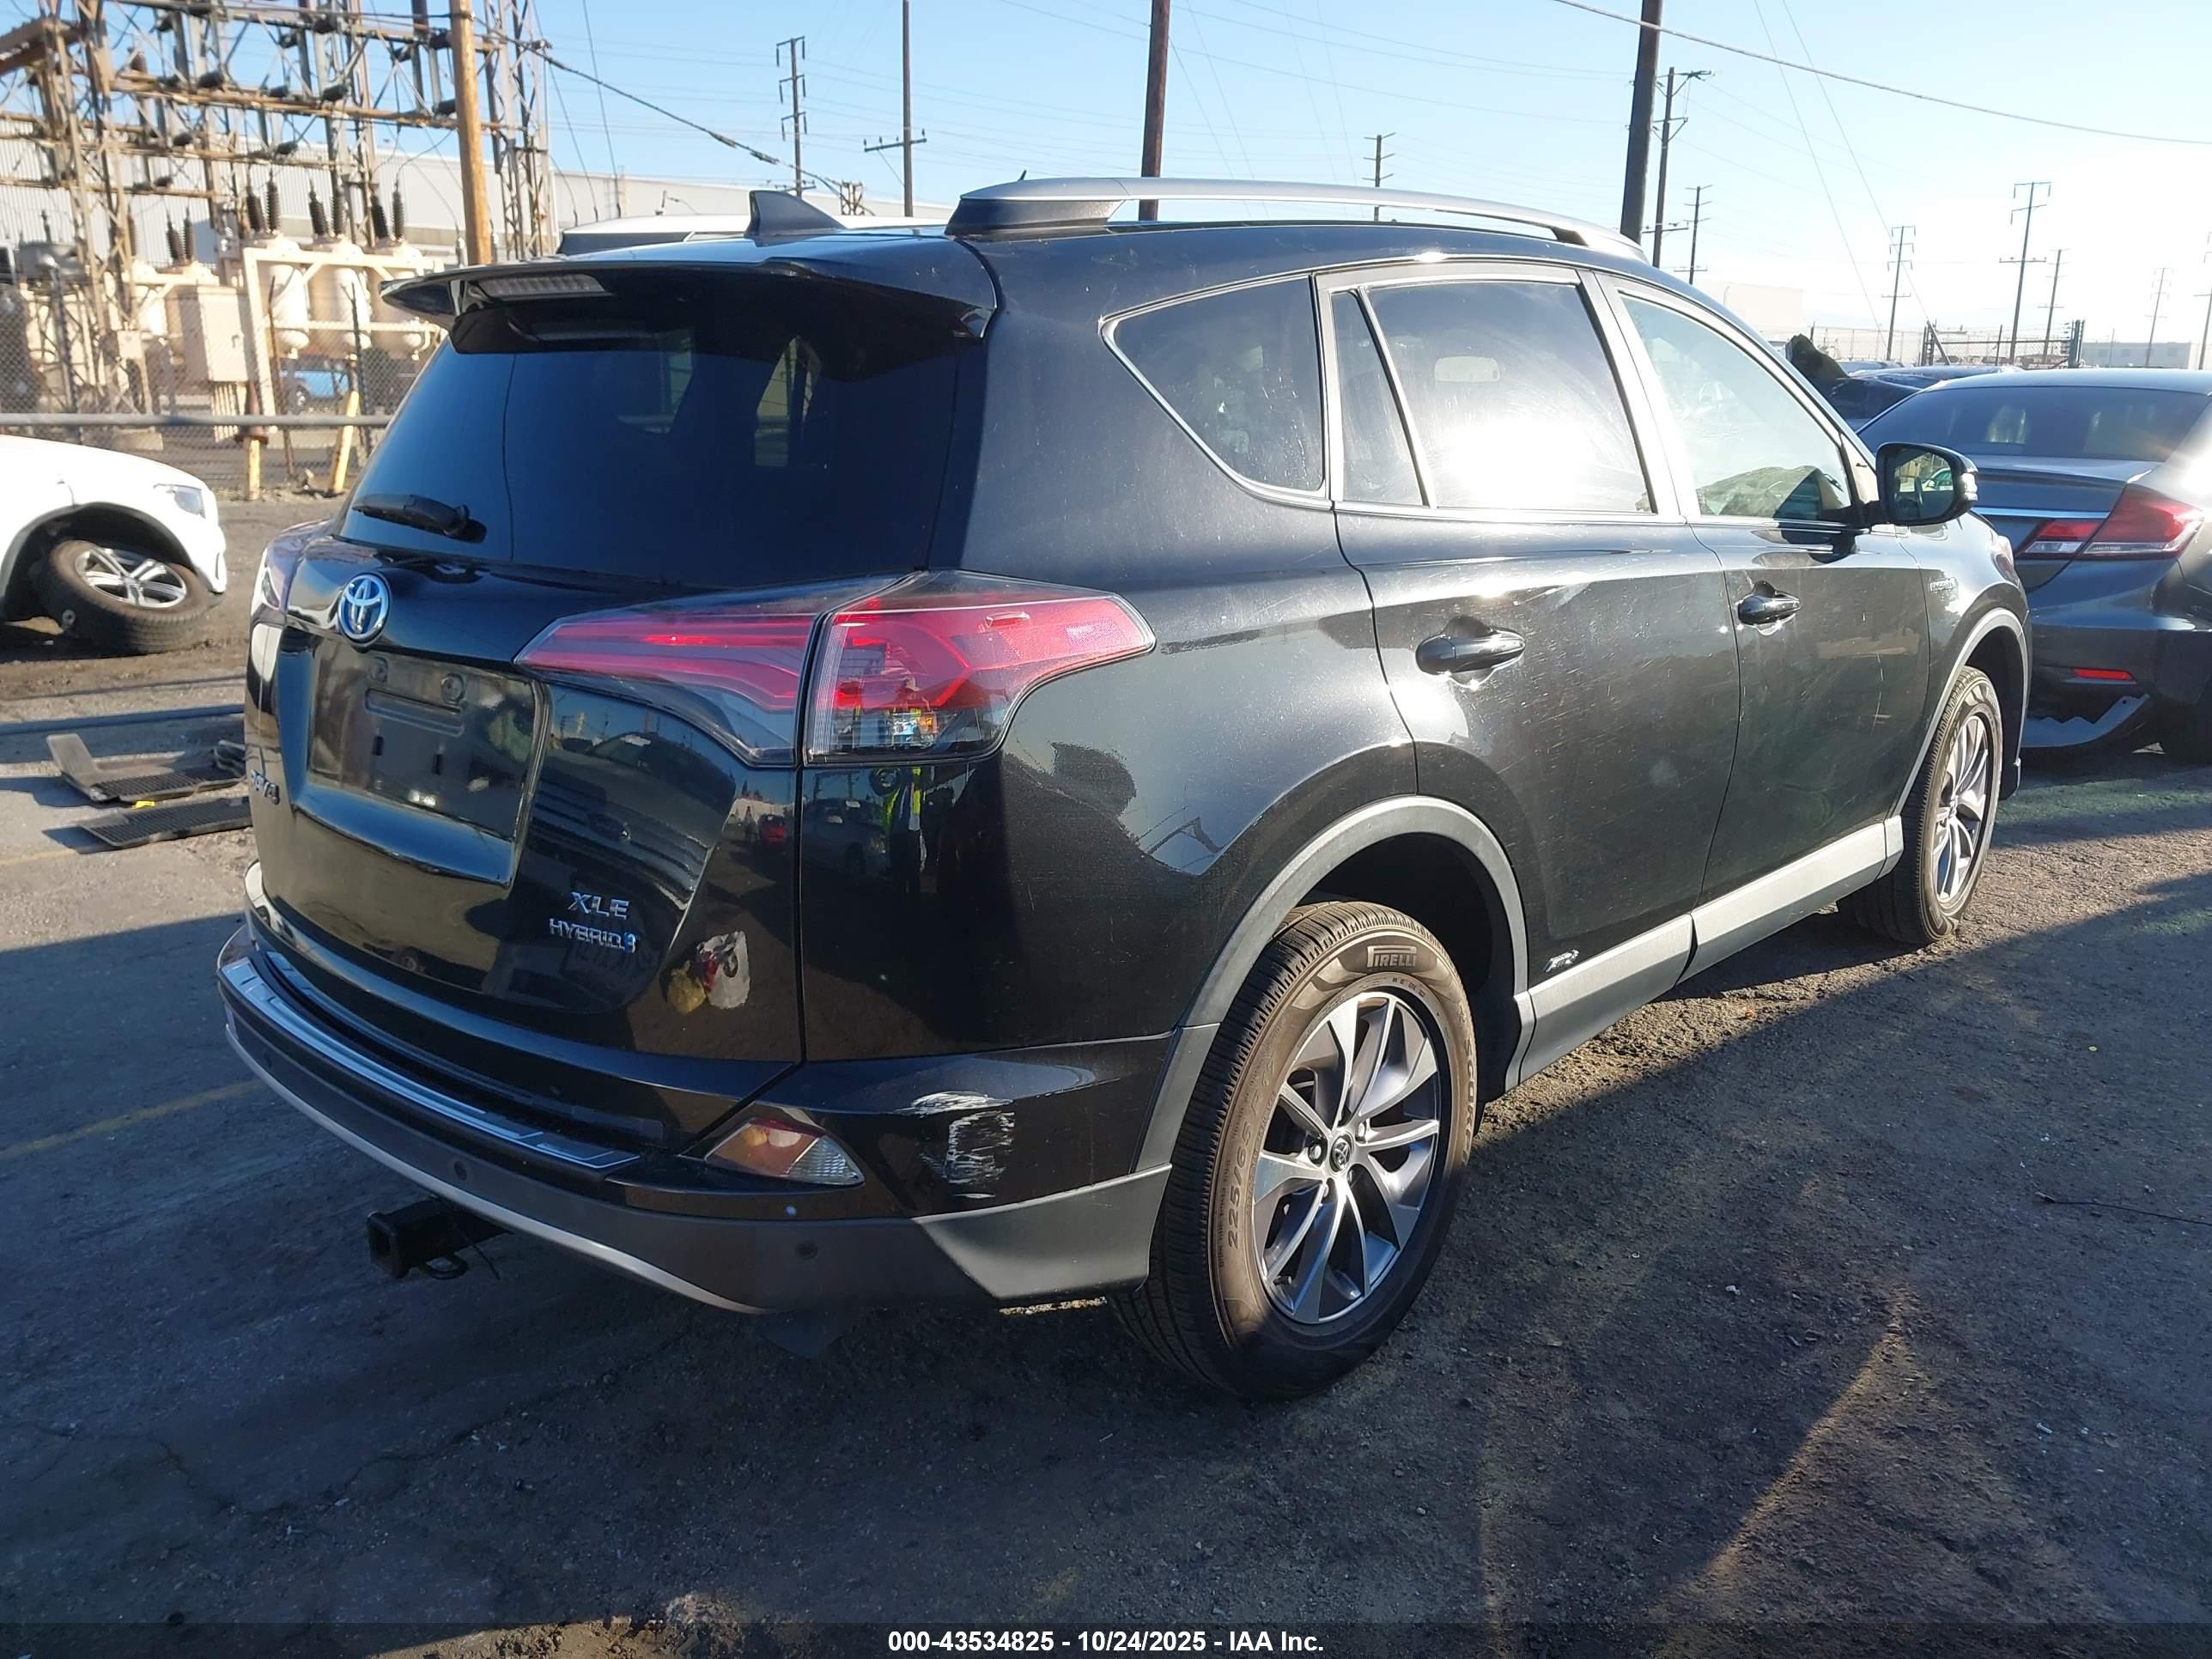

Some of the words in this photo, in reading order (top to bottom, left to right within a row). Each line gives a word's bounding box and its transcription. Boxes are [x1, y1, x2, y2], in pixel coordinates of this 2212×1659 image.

[568, 891, 629, 920] XLE
[550, 918, 625, 951] HYBRID
[1367, 945, 1417, 968] PIRELLI
[1227, 1121, 1252, 1250] 225/65
